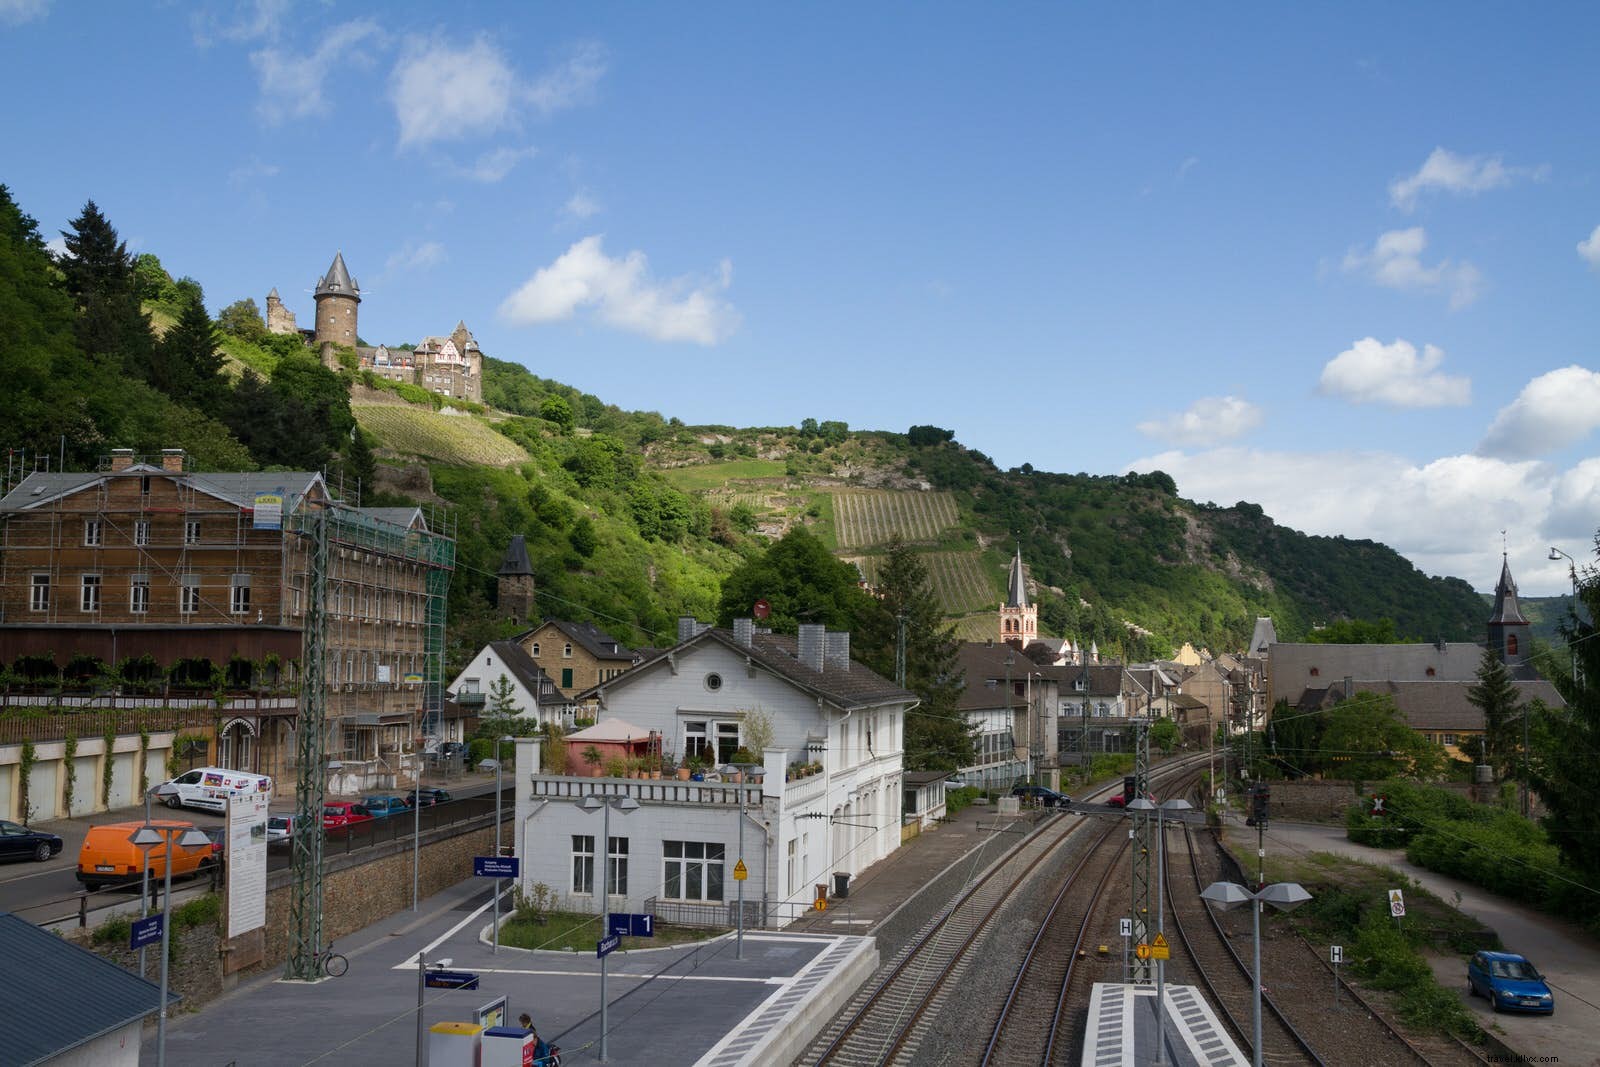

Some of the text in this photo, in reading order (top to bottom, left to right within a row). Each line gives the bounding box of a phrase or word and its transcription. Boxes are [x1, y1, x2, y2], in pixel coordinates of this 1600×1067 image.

[643, 915, 650, 932] 1
[1121, 921, 1131, 933] H
[1332, 947, 1342, 961] H
